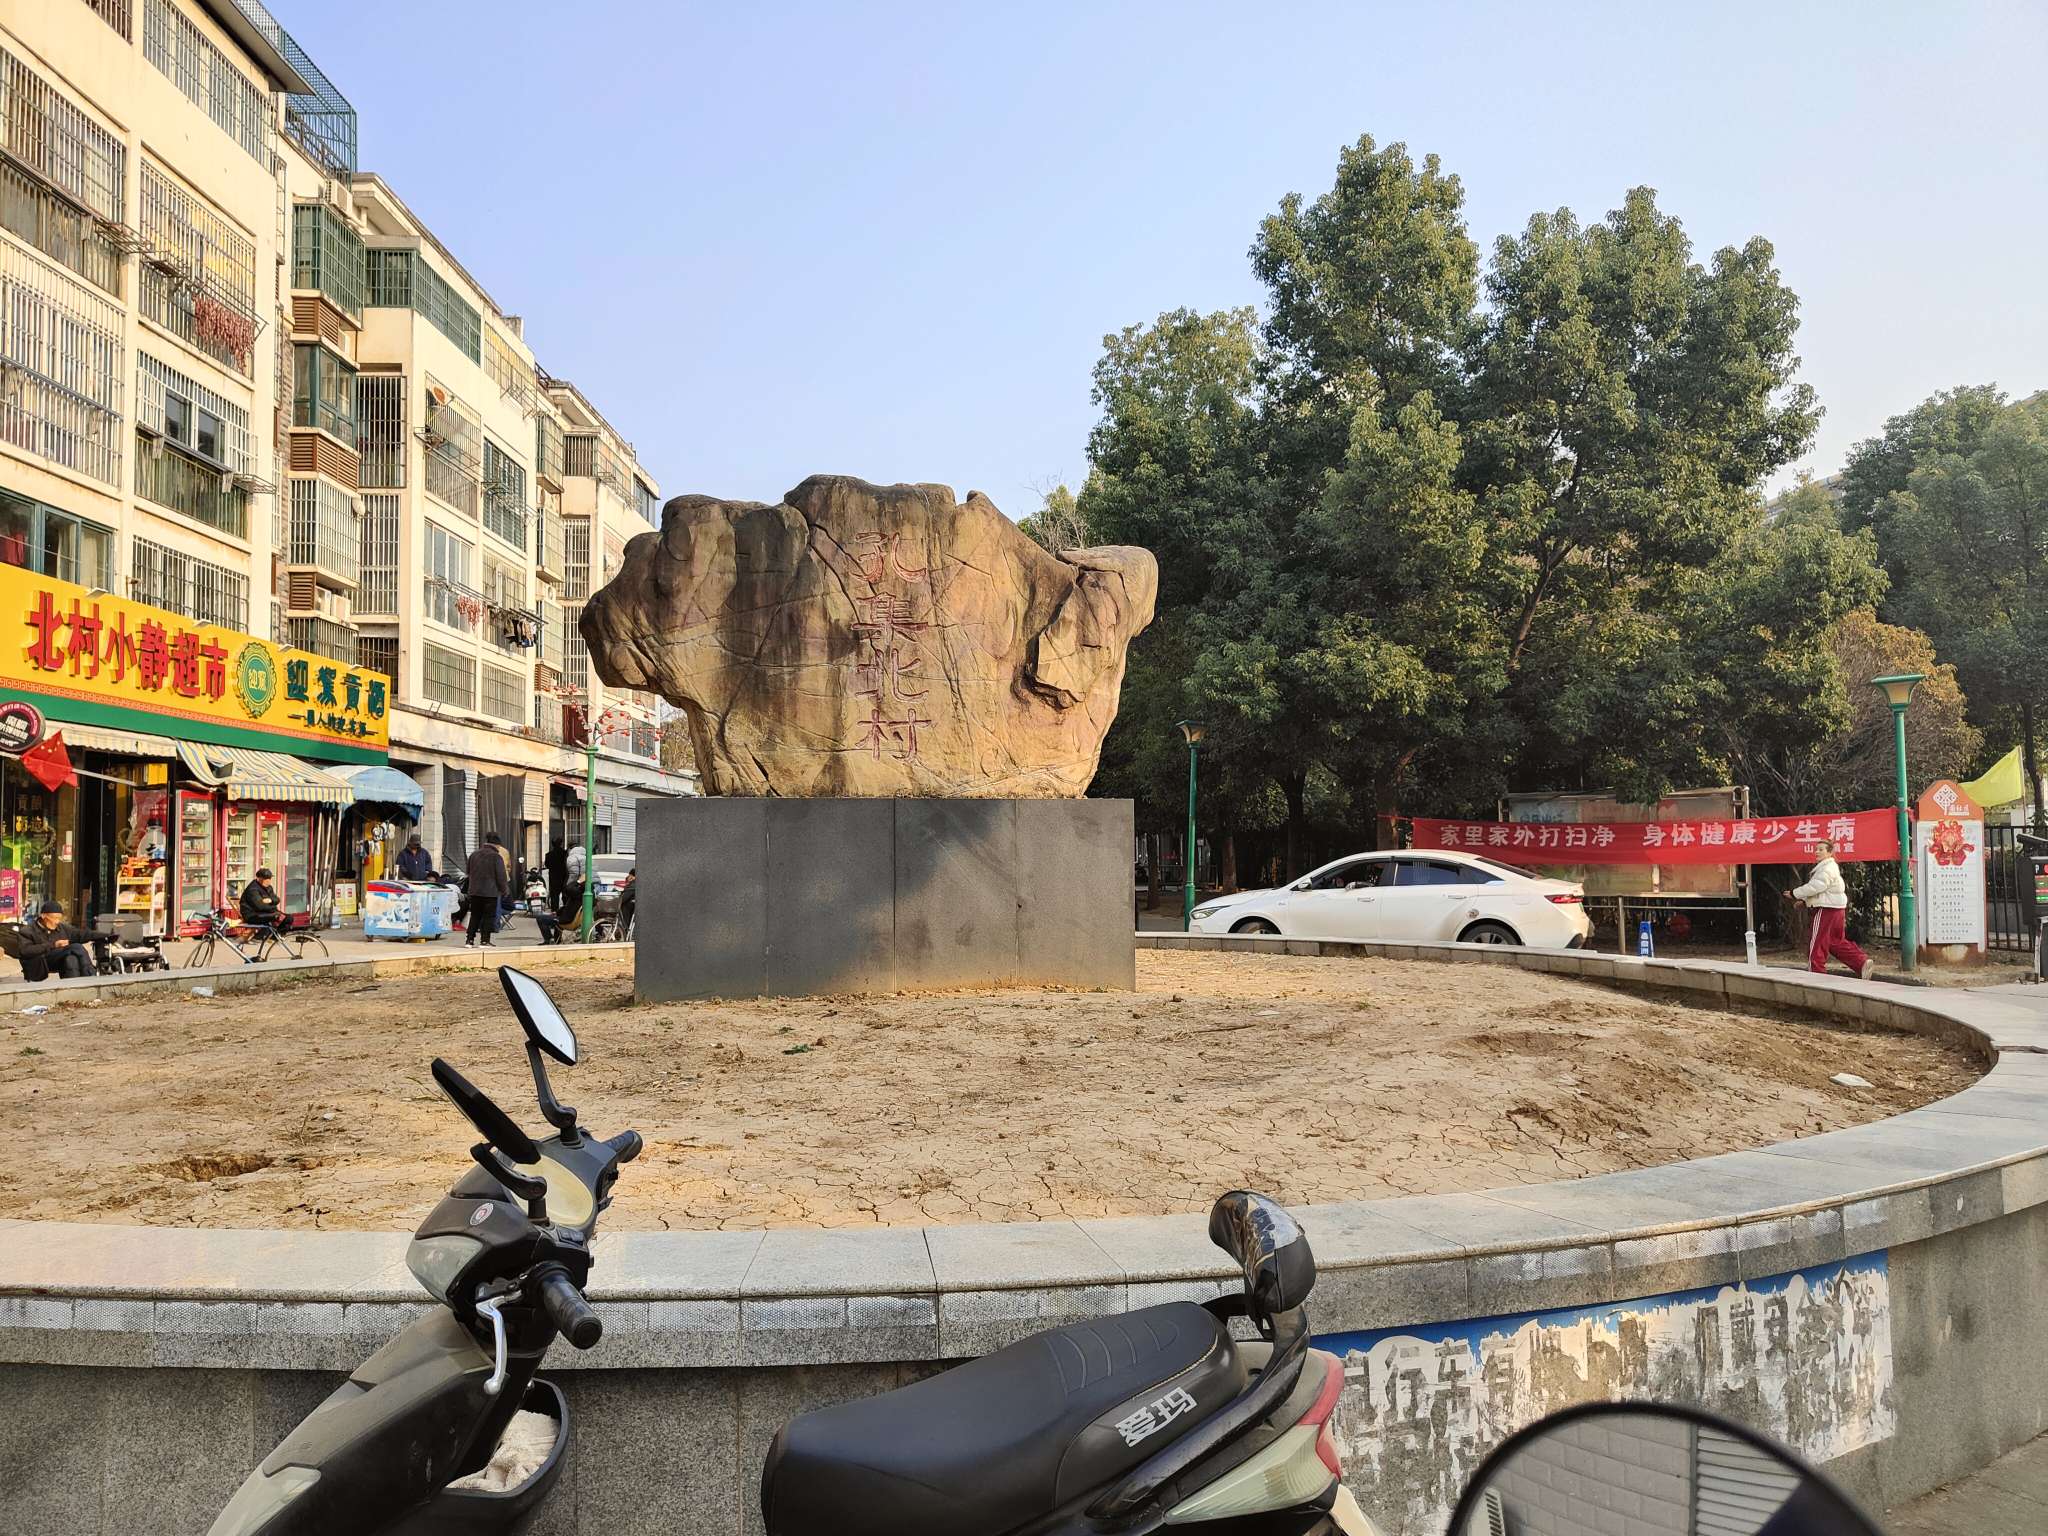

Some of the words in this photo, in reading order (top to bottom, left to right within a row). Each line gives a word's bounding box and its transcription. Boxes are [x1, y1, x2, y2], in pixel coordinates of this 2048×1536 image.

[27, 590, 229, 702] 北村小静超市
[1440, 823, 1616, 848] 家里家外打扫净
[1642, 816, 1856, 847] 身体健康少生病
[1113, 1386, 1198, 1448] 爱玛
